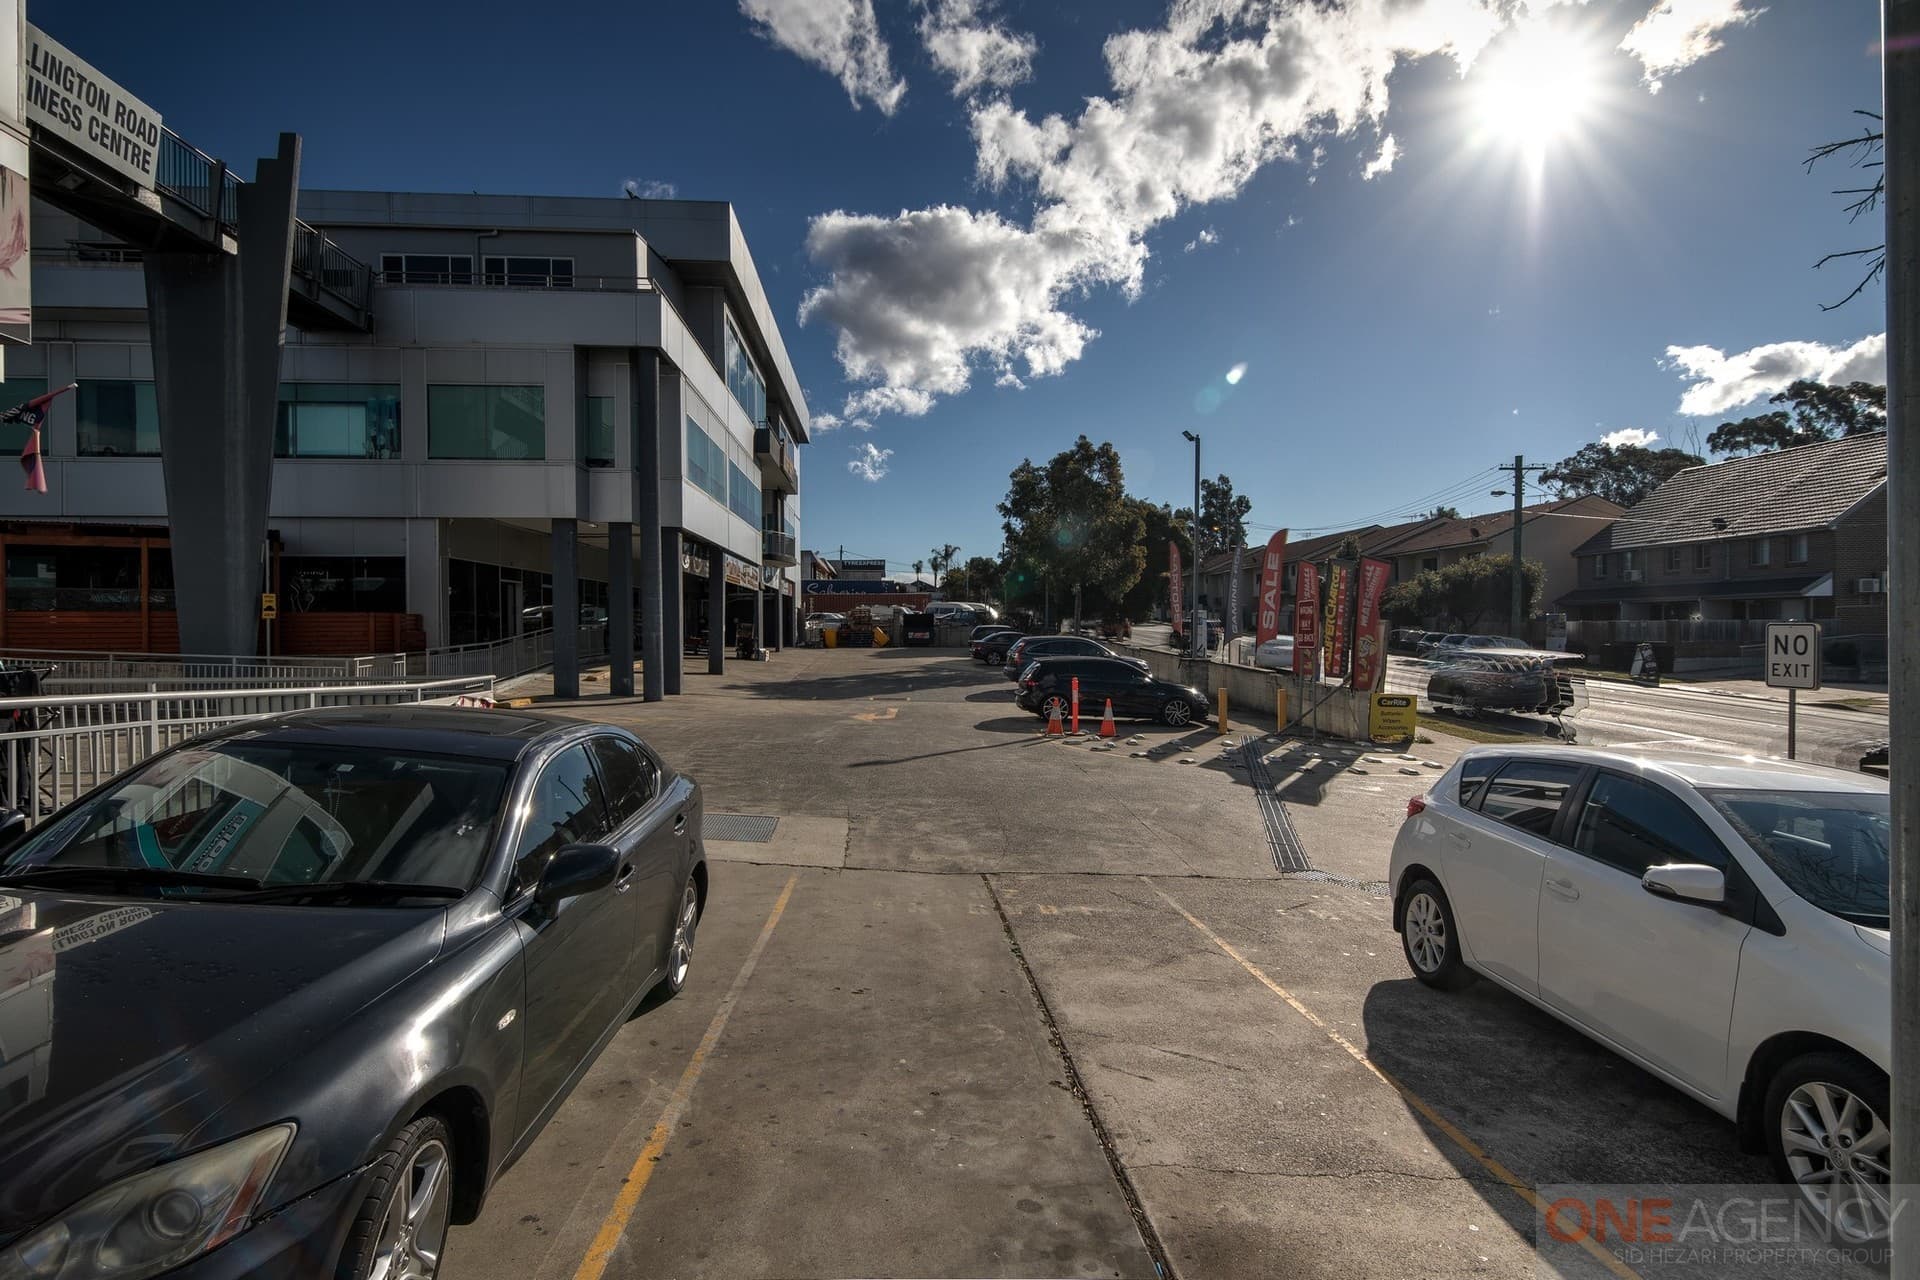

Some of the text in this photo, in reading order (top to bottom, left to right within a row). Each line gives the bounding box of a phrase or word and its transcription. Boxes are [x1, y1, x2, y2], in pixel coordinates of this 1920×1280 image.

[26, 42, 158, 148] LINGTON ROAD
[26, 74, 152, 174] INESS CENTRE
[1262, 552, 1280, 630] SALE
[1332, 569, 1347, 674] BATTERIES
[1771, 662, 1811, 678] EXIT
[1774, 634, 1808, 655] NO
